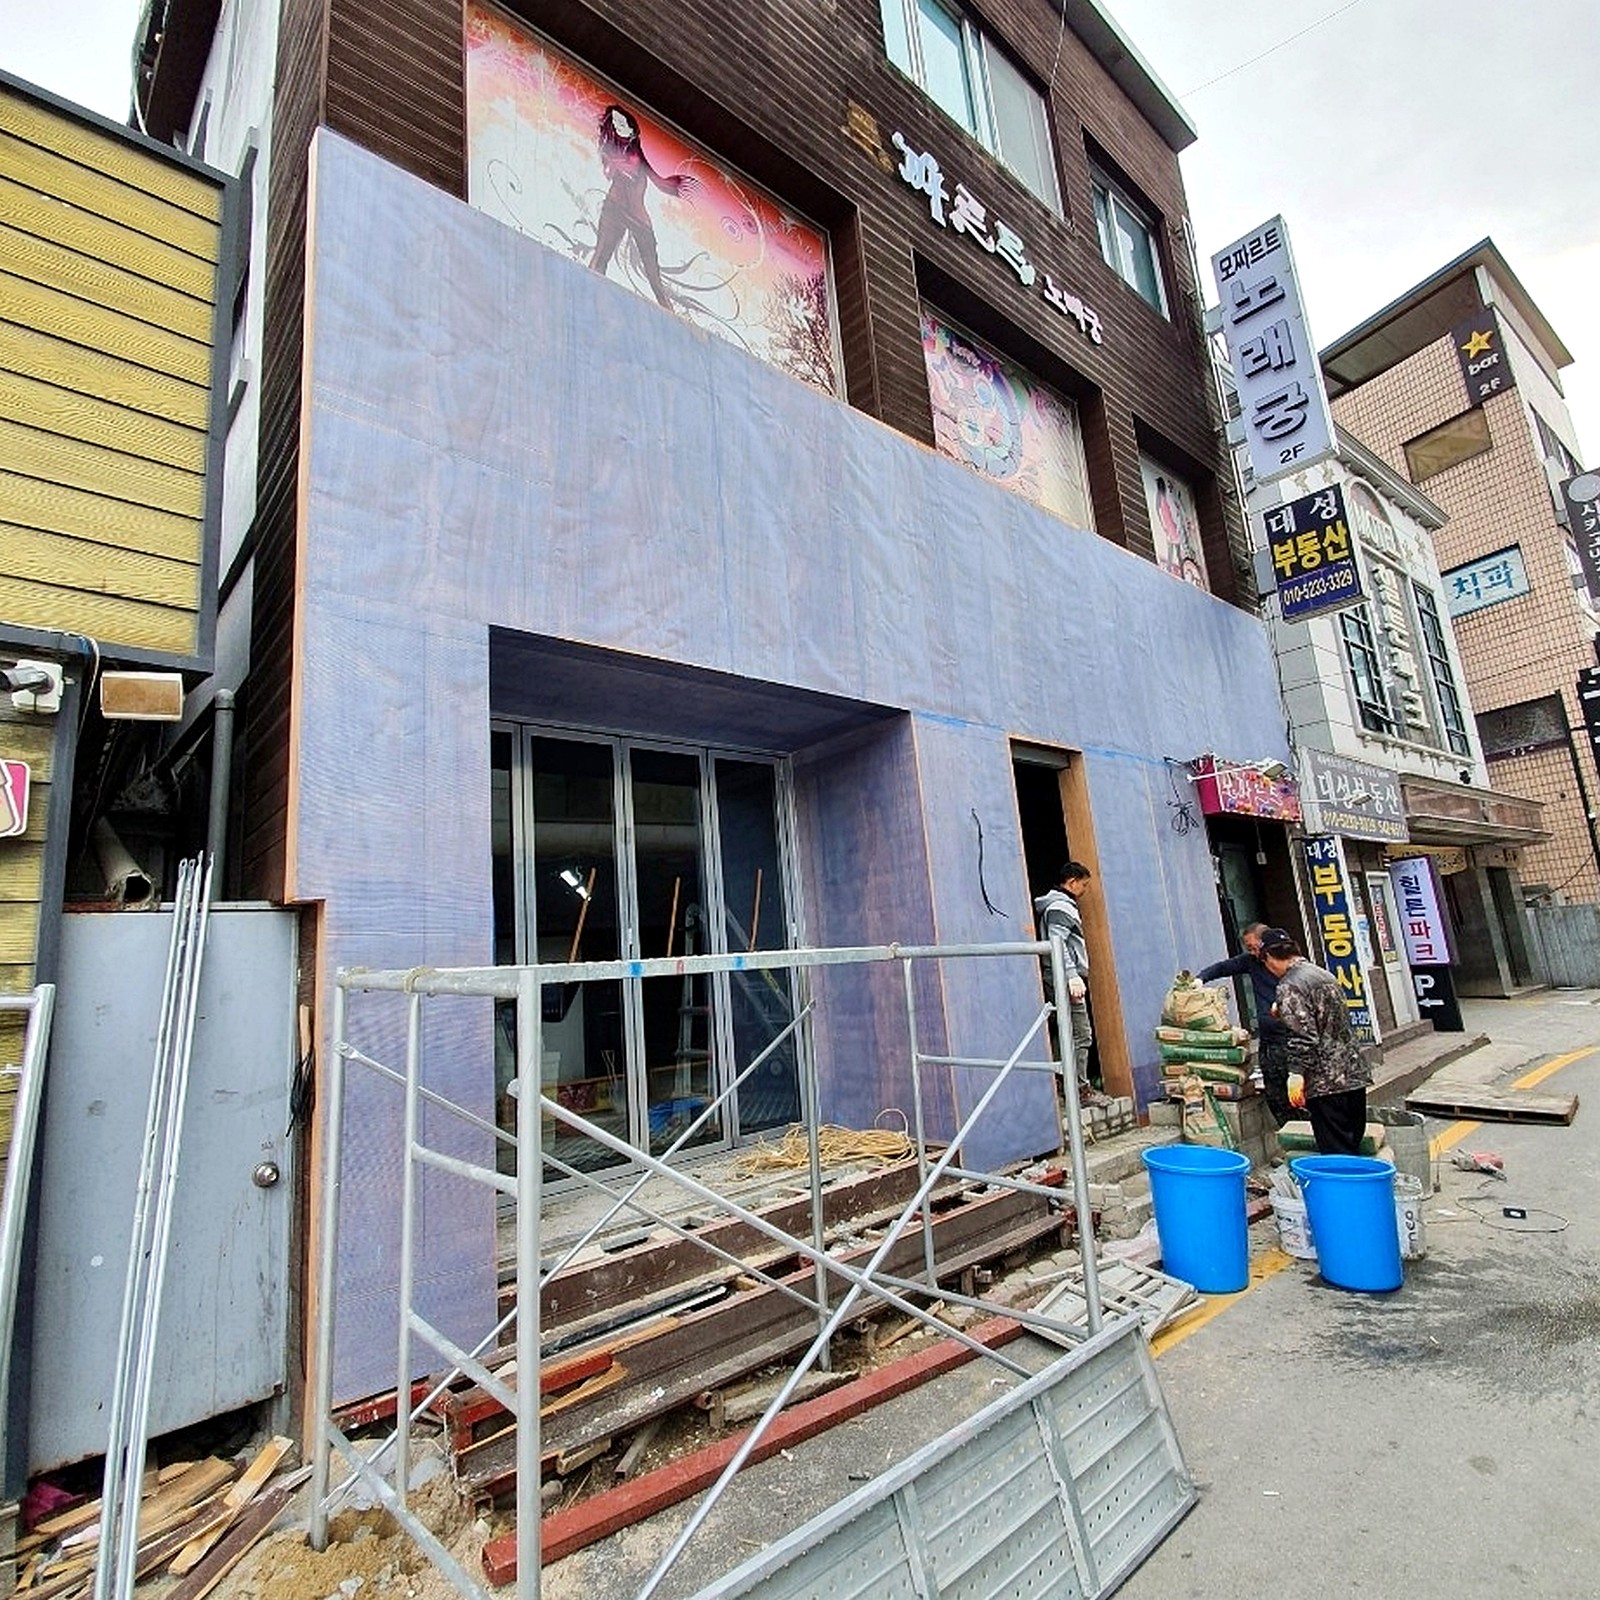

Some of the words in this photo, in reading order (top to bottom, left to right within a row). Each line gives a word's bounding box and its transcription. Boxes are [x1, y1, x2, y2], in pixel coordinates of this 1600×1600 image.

[1219, 227, 1282, 282] 모짜르트
[1230, 275, 1310, 442] 노래궁
[1468, 353, 1499, 376] bar
[1479, 377, 1501, 396] 2F
[1279, 442, 1306, 465] 2F
[1273, 520, 1349, 577] 부동산
[1283, 569, 1353, 606] 010-5233-3329
[1306, 839, 1337, 860] 대성
[1313, 862, 1365, 1008] 부동산
[1414, 974, 1436, 997] P
